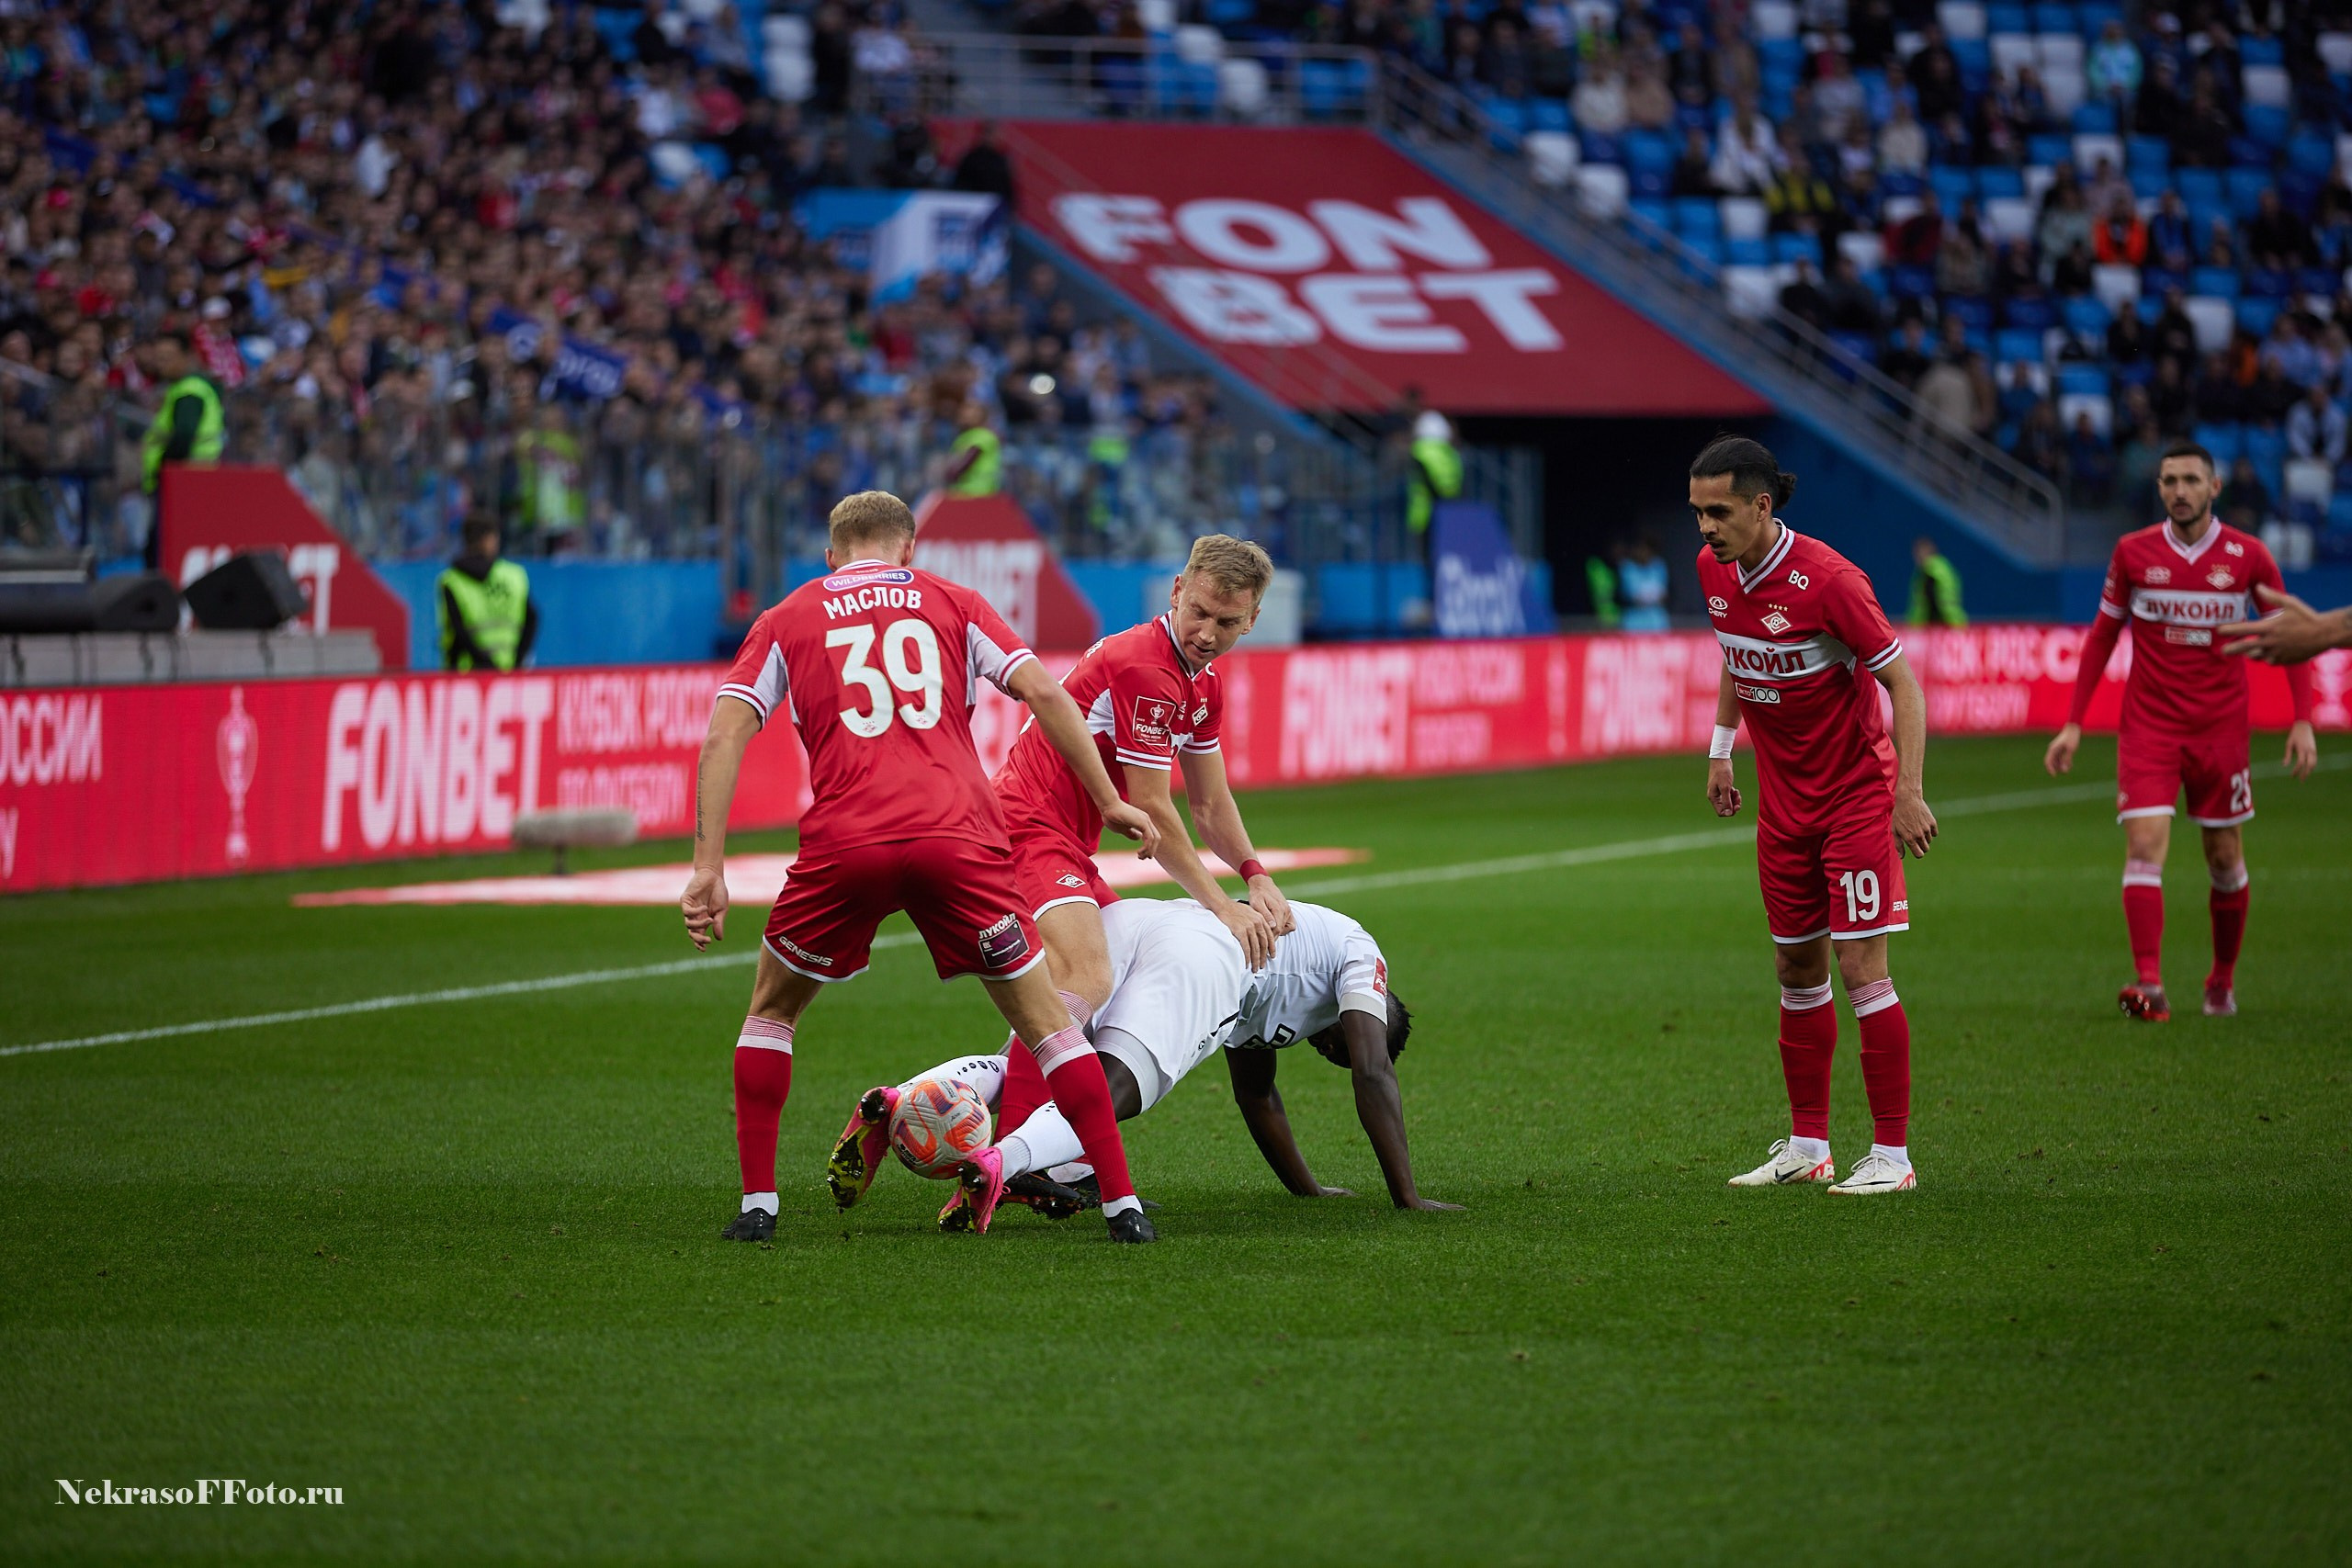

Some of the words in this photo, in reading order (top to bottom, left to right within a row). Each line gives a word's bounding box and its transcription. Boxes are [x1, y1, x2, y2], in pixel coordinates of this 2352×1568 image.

[1052, 193, 1492, 272] FON
[1149, 265, 1563, 353] BET
[831, 572, 906, 587] WILDBERRIES
[1788, 570, 1809, 590] BQ
[822, 586, 922, 620] МАСЛОВ
[1721, 643, 1806, 673] УКОЙЛ
[825, 618, 943, 738] 39
[1136, 723, 1170, 736] FONBET
[321, 676, 552, 854] FONBET
[1839, 869, 1881, 922] 19
[978, 912, 1016, 939] ЛУКОЙЛ
[778, 935, 834, 967] GENESIS
